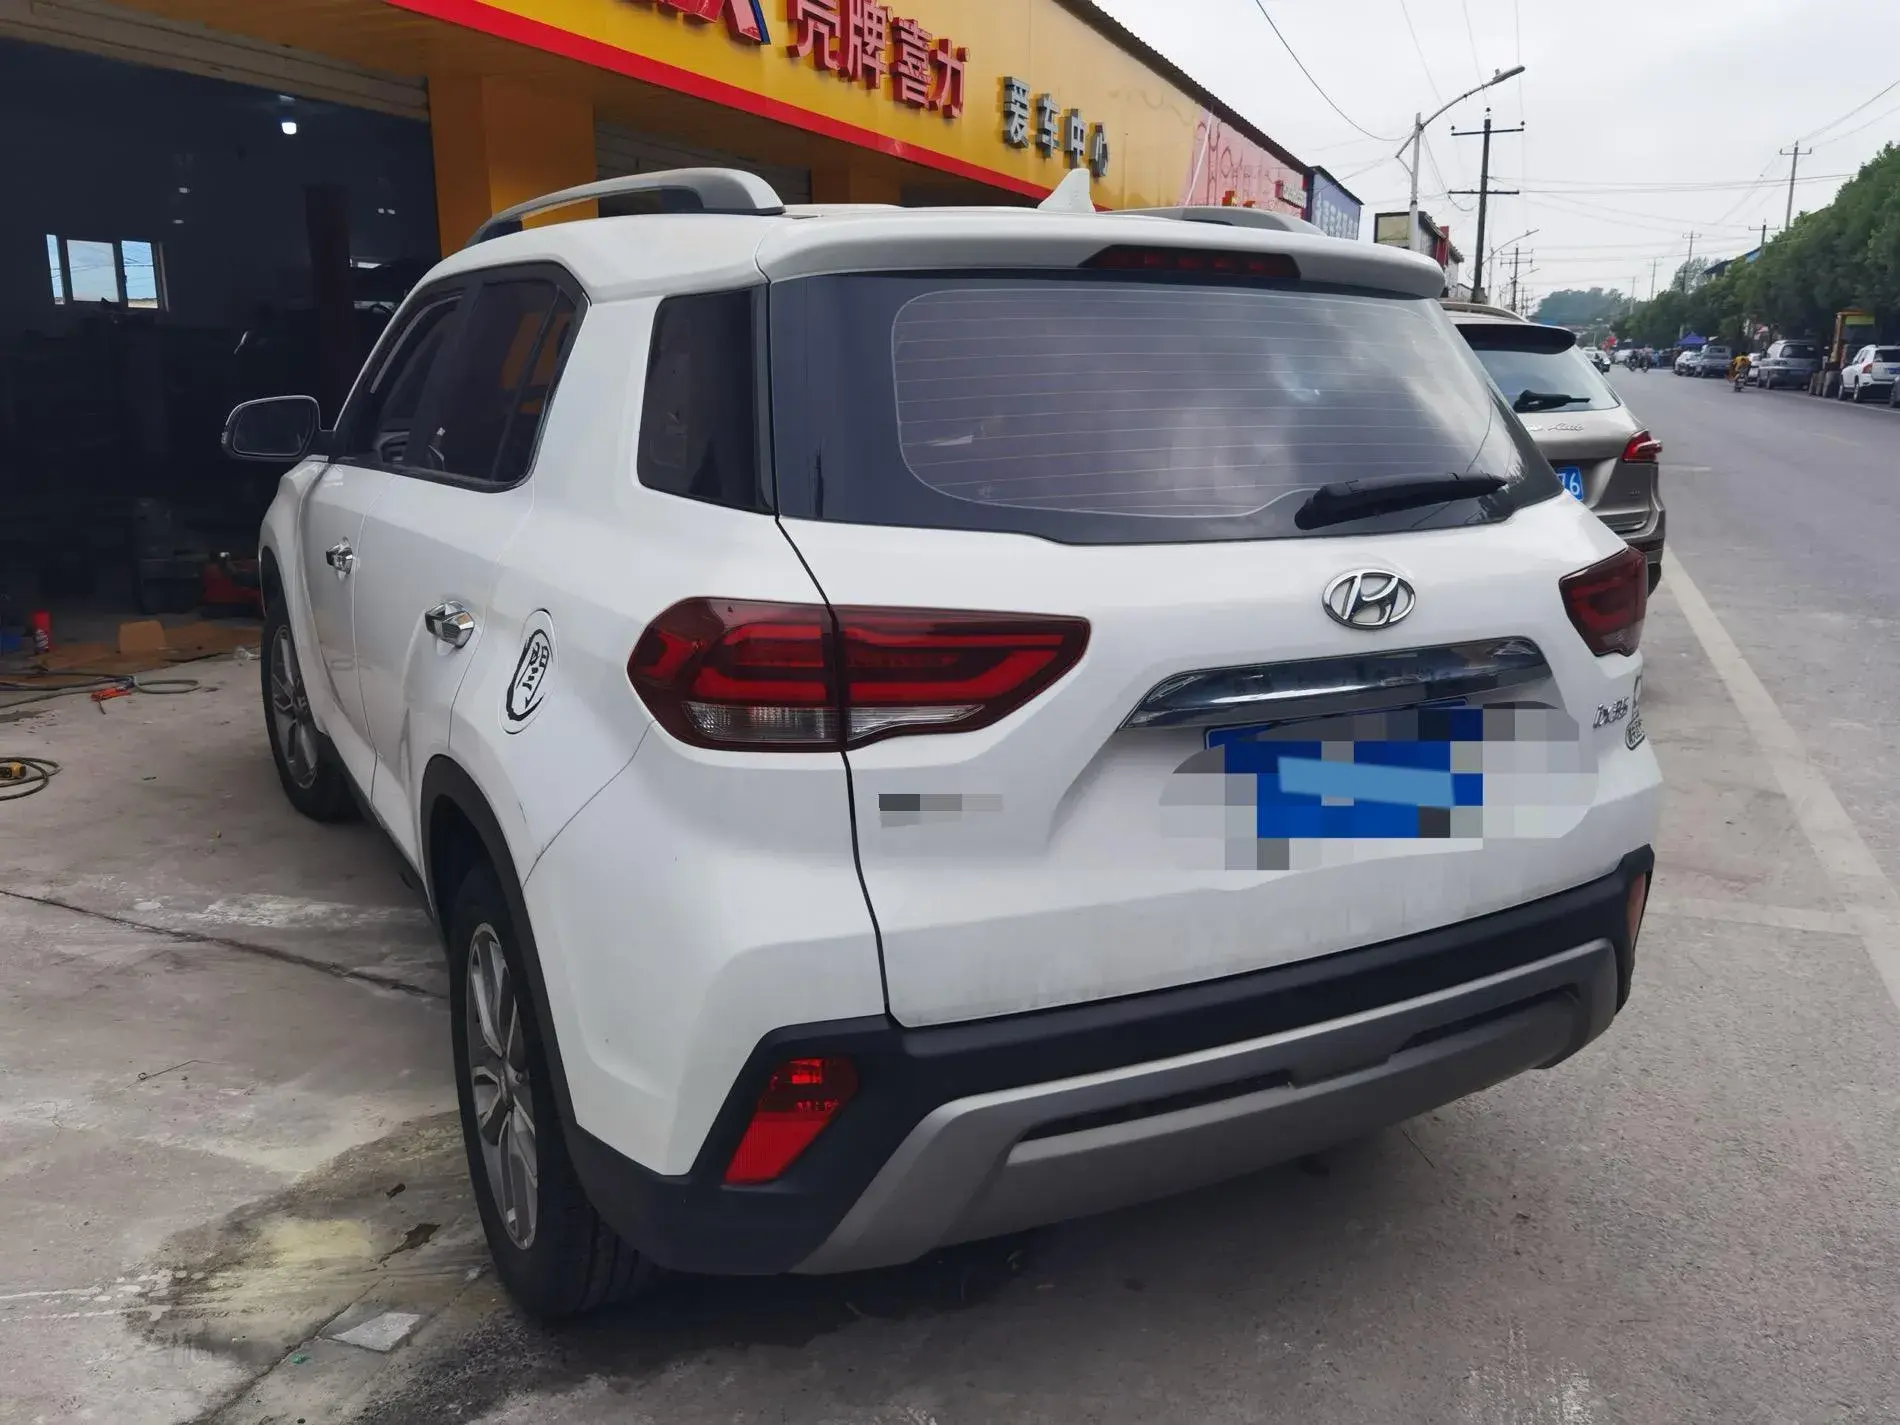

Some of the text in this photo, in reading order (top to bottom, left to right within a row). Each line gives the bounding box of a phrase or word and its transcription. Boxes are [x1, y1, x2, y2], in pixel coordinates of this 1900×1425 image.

[787, 0, 964, 119] 壳牌喜力
[1003, 76, 1108, 177] 爱车中心
